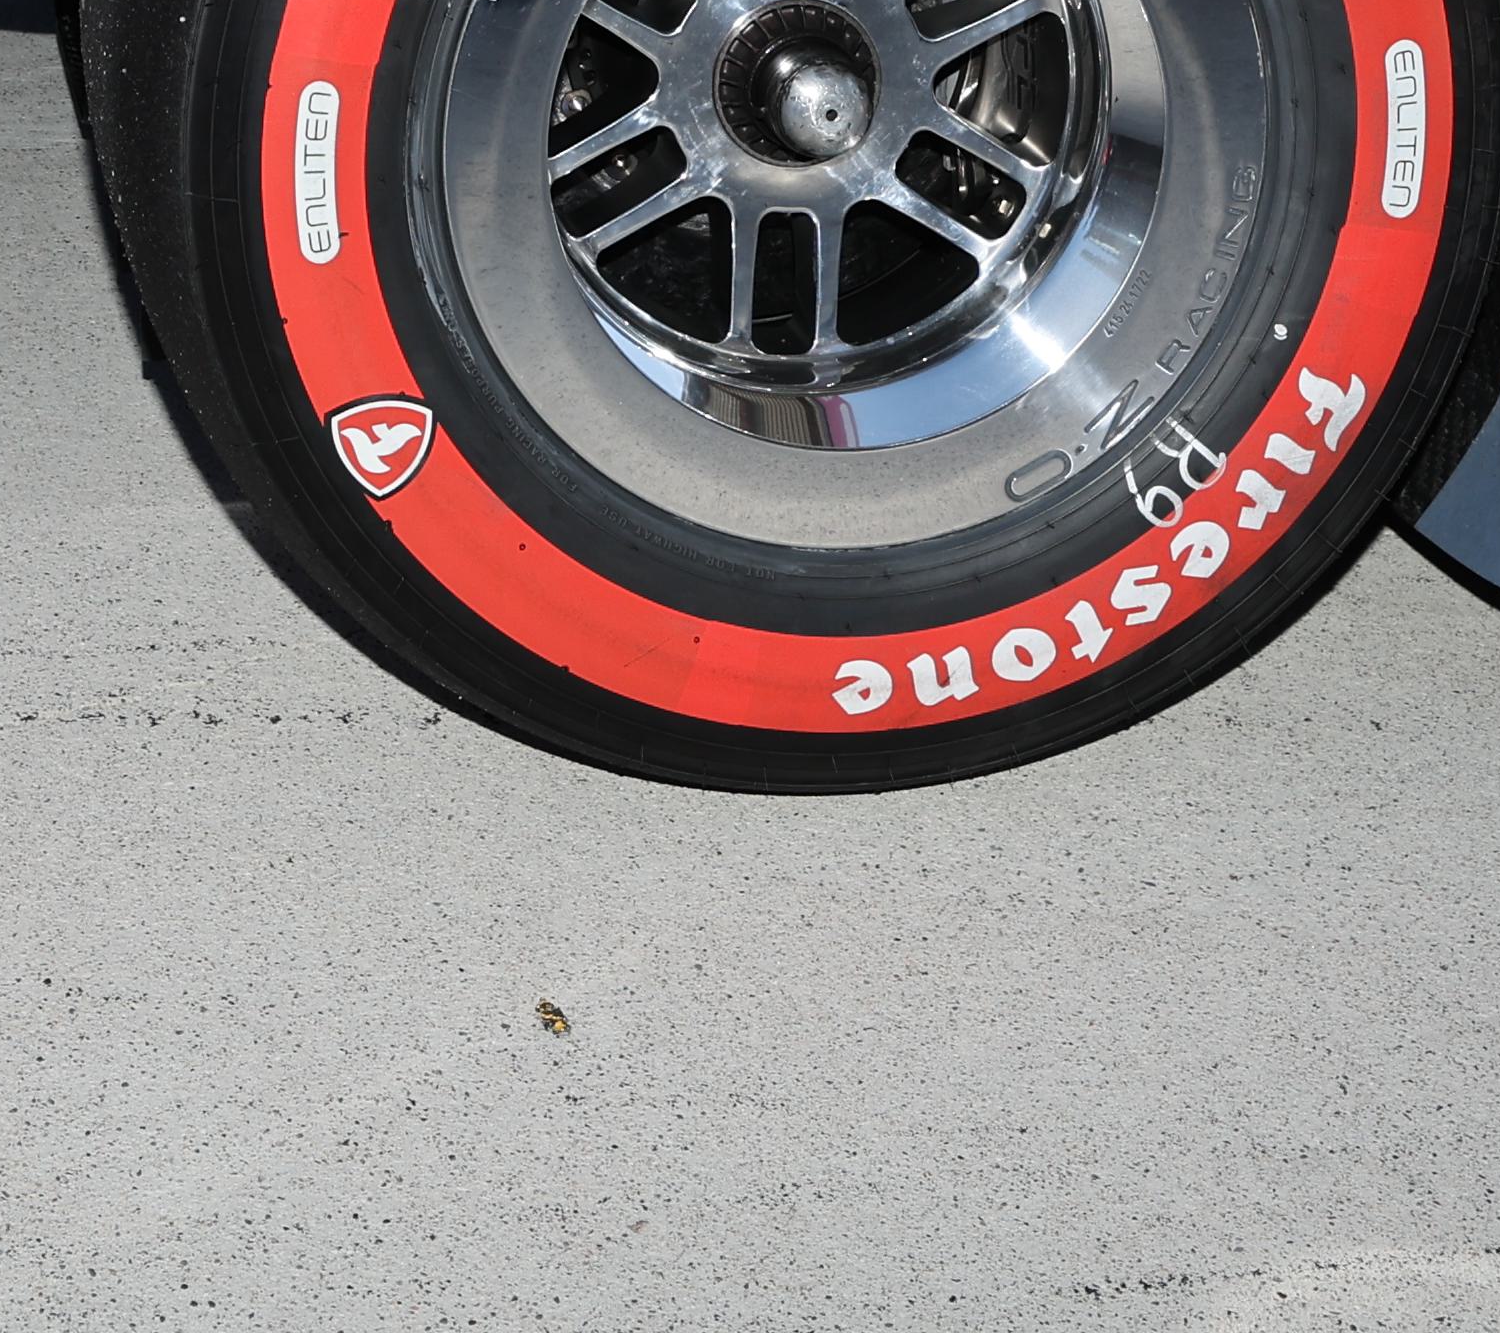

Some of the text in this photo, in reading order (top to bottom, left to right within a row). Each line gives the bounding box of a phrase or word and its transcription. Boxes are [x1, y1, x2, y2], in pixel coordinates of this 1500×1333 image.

[300, 89, 333, 256] ENLITEN
[1388, 49, 1419, 209] ENLITEN
[1155, 165, 1258, 375] RACING
[832, 366, 1368, 717] Firestone
